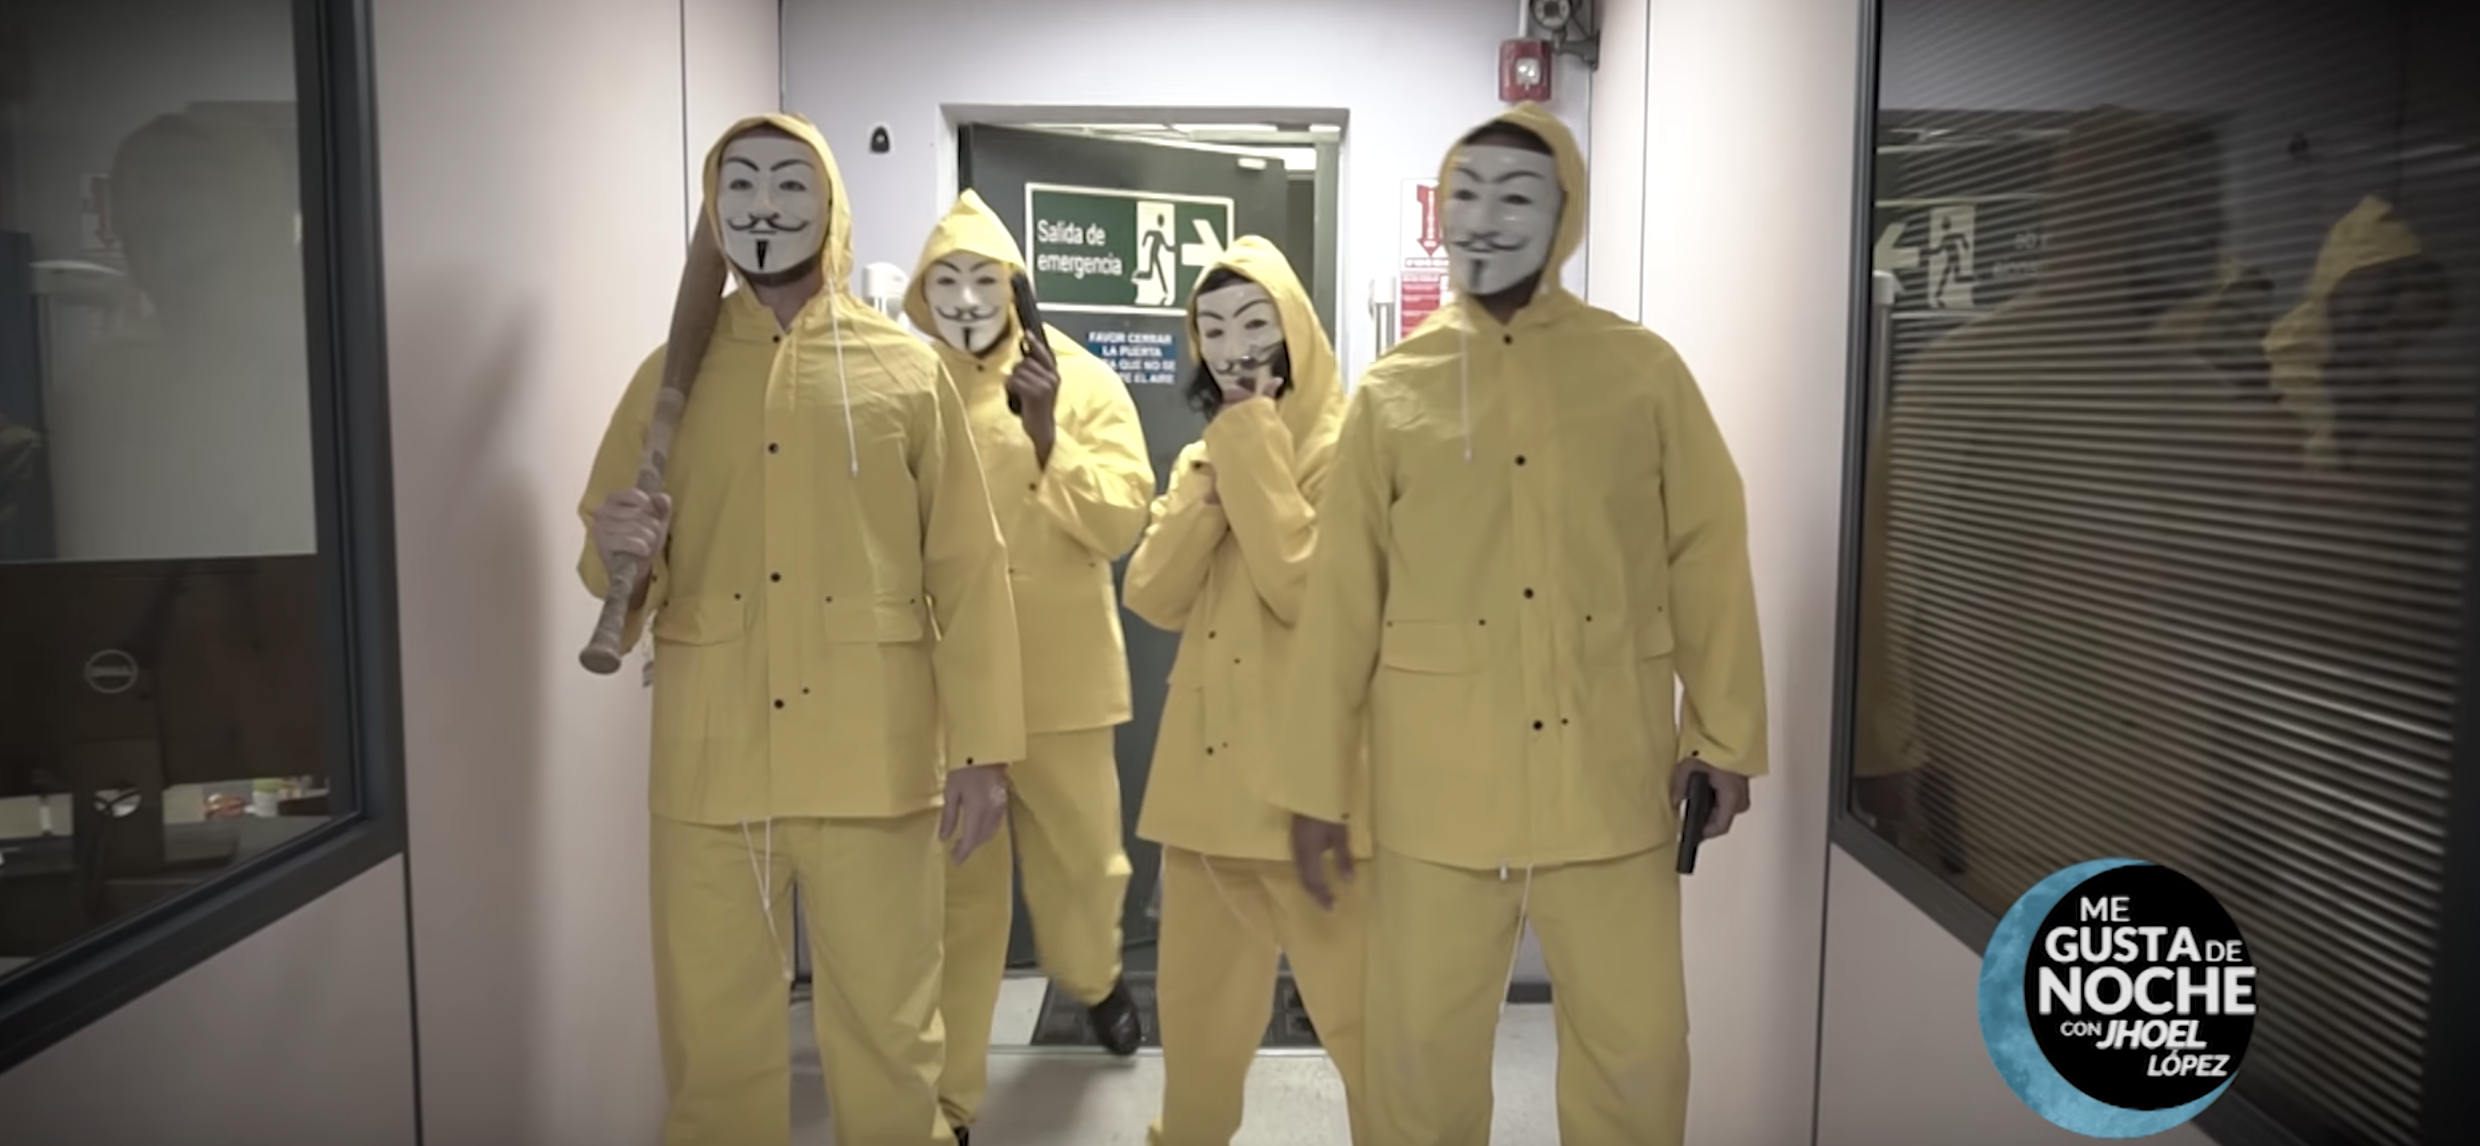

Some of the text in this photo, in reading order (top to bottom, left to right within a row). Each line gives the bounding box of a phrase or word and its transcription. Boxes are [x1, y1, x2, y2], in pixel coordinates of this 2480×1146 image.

[1037, 219, 1106, 246] Salida de
[1037, 252, 1123, 279] emergencia
[1088, 331, 1173, 344] FAVOR CERRAR
[1101, 345, 1163, 357] LA PUERTA
[1118, 360, 1141, 370] QUE
[1143, 361, 1161, 371] NO
[1162, 361, 1176, 372] SE
[1134, 372, 1148, 383] EL
[1149, 373, 1175, 385] AIRE
